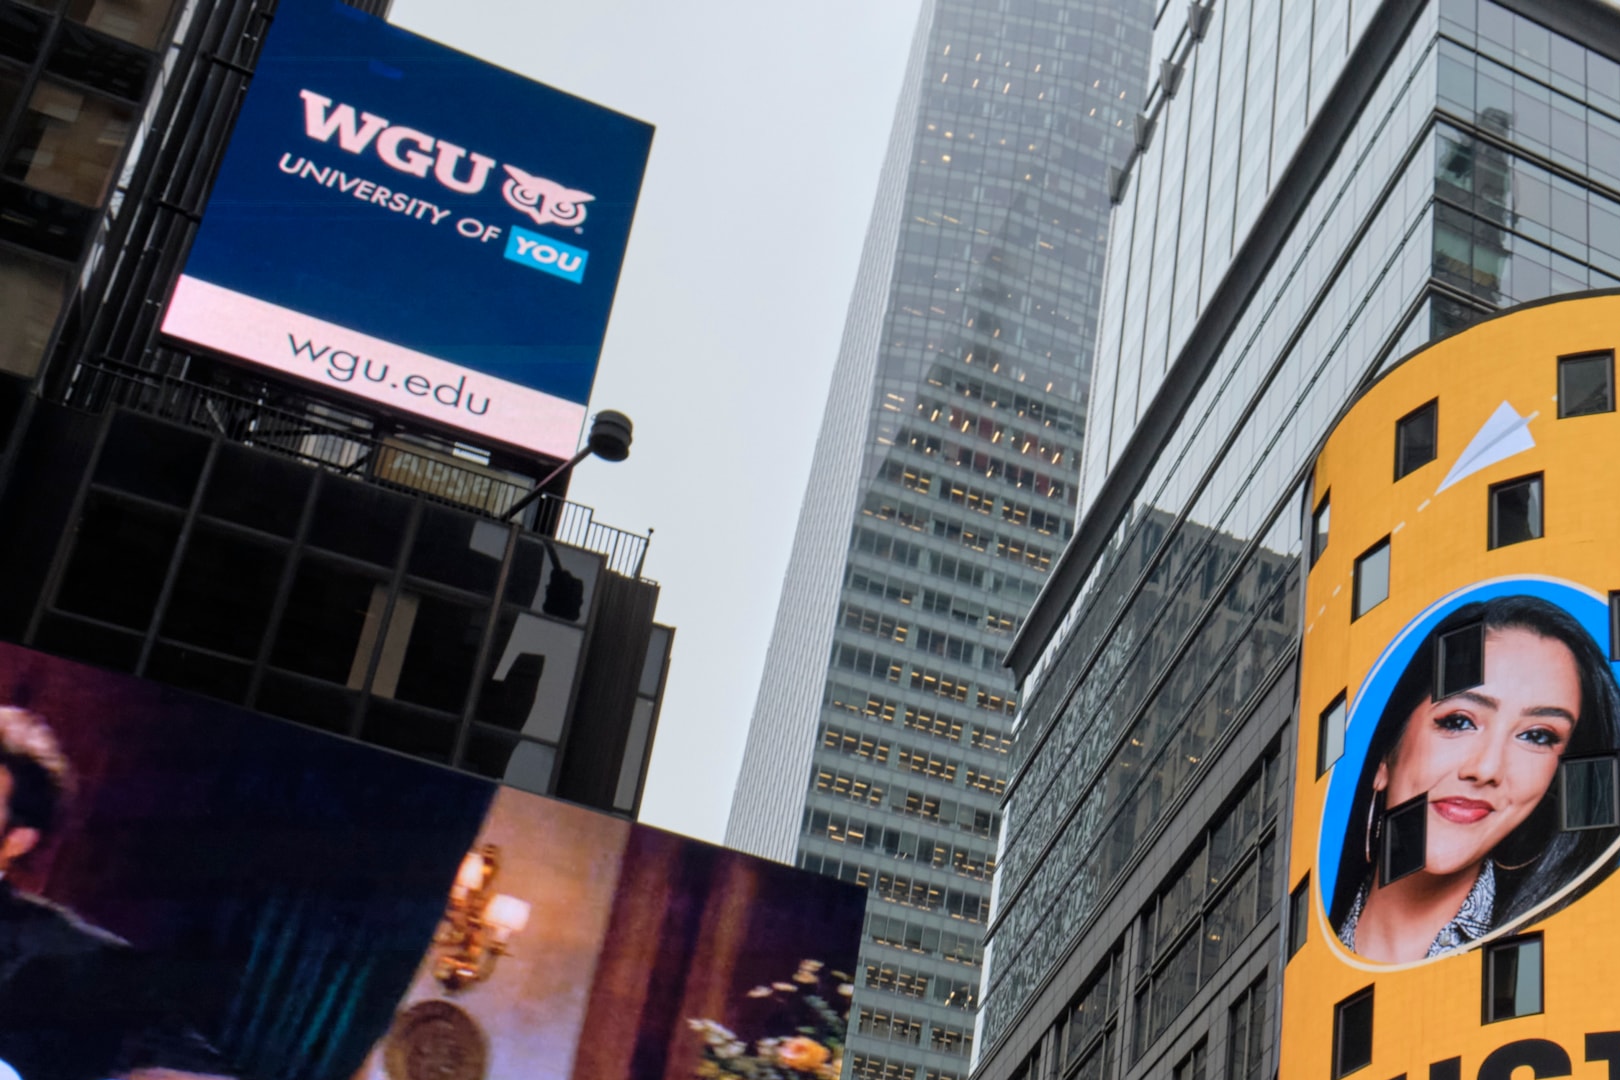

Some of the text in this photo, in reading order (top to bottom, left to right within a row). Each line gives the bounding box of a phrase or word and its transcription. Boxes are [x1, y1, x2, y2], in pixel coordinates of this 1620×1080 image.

[300, 89, 495, 193] WGU
[279, 153, 582, 271] UNIVERSITY OF YOU
[288, 333, 490, 416] wgu.edu
